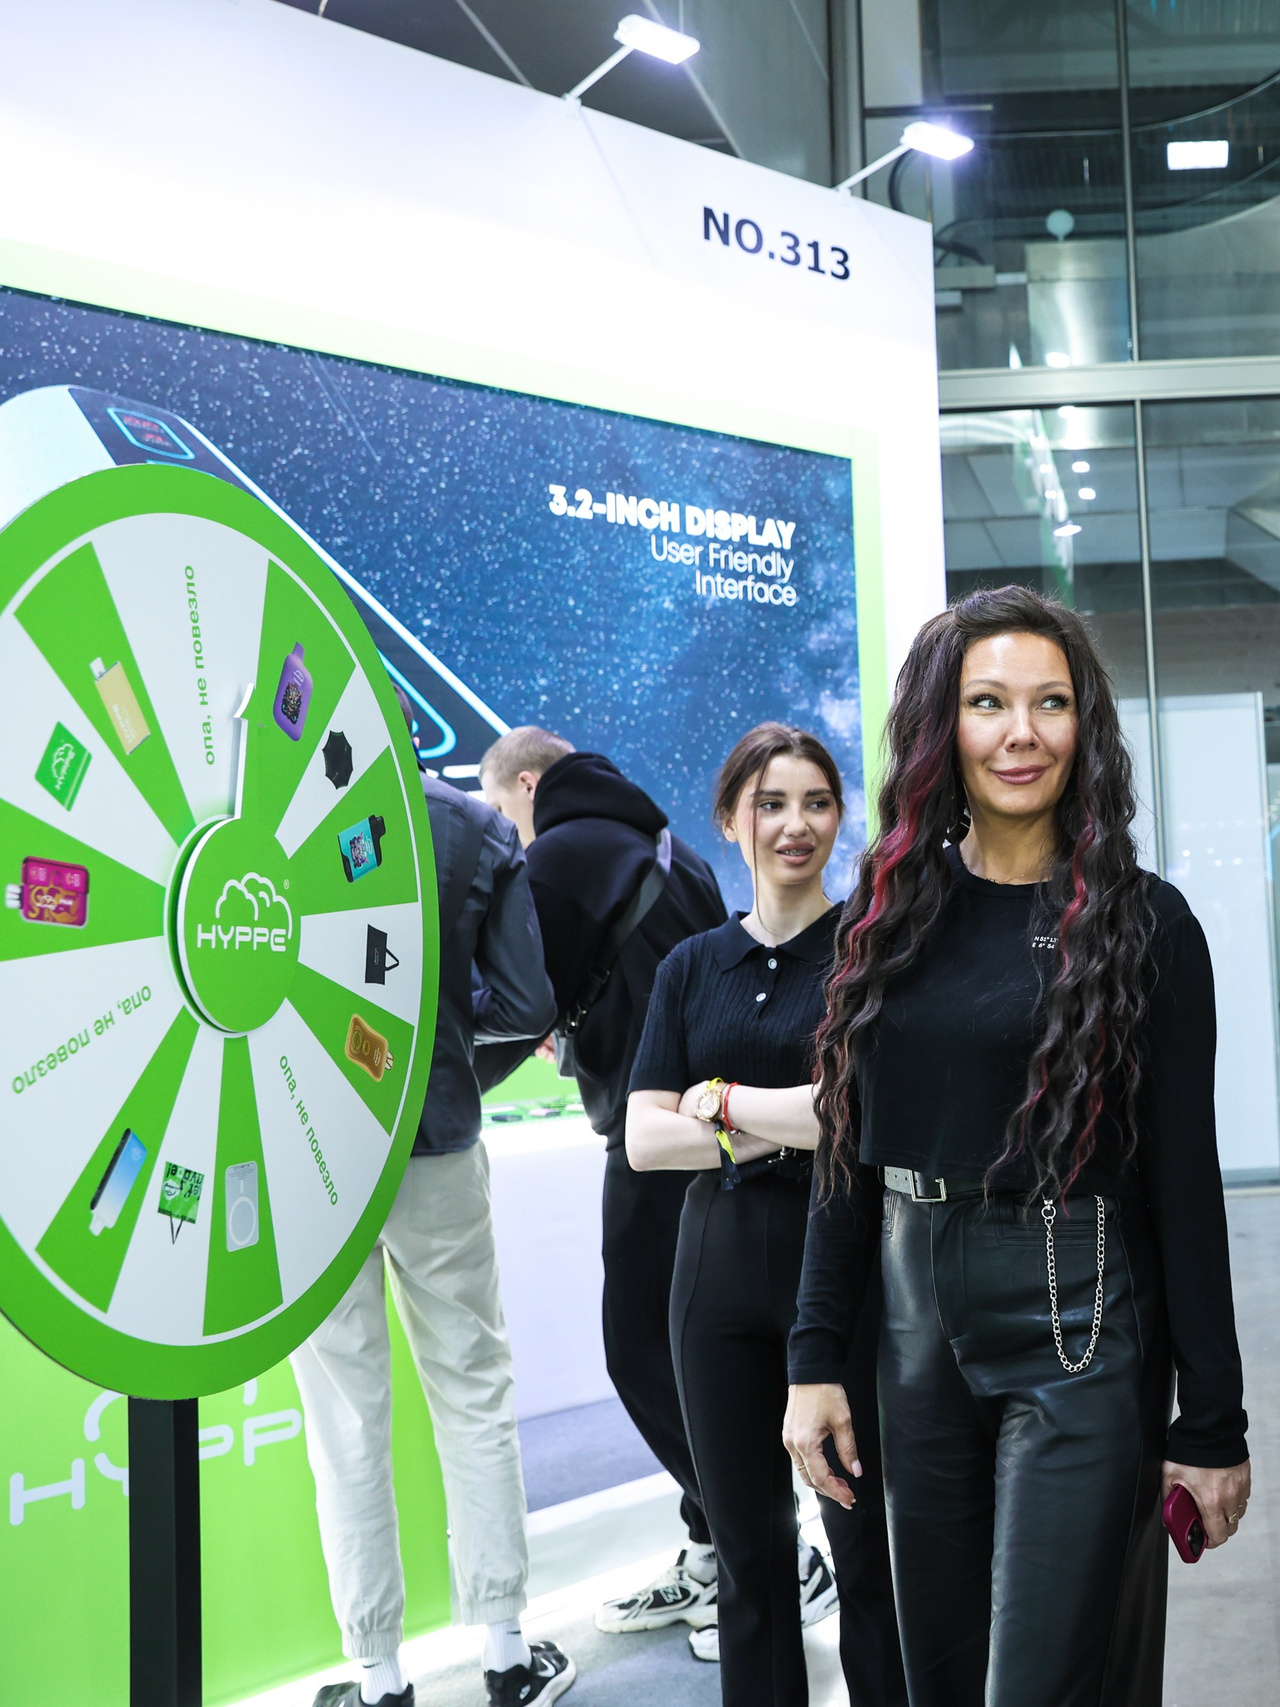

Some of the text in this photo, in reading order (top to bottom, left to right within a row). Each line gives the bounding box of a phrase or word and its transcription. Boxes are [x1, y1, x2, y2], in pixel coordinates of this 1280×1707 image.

[702, 205, 852, 281] NO.313
[548, 484, 796, 550] 3.2-INCH DISPLAY
[651, 534, 795, 584] User Friendly
[695, 570, 797, 607] Interface
[183, 565, 205, 670] повезло
[197, 677, 209, 707] не
[196, 923, 287, 952] HYPPE
[93, 1011, 116, 1037] не
[11, 1030, 91, 1095] повезло
[296, 1100, 309, 1124] не
[305, 1126, 339, 1206] повезло
